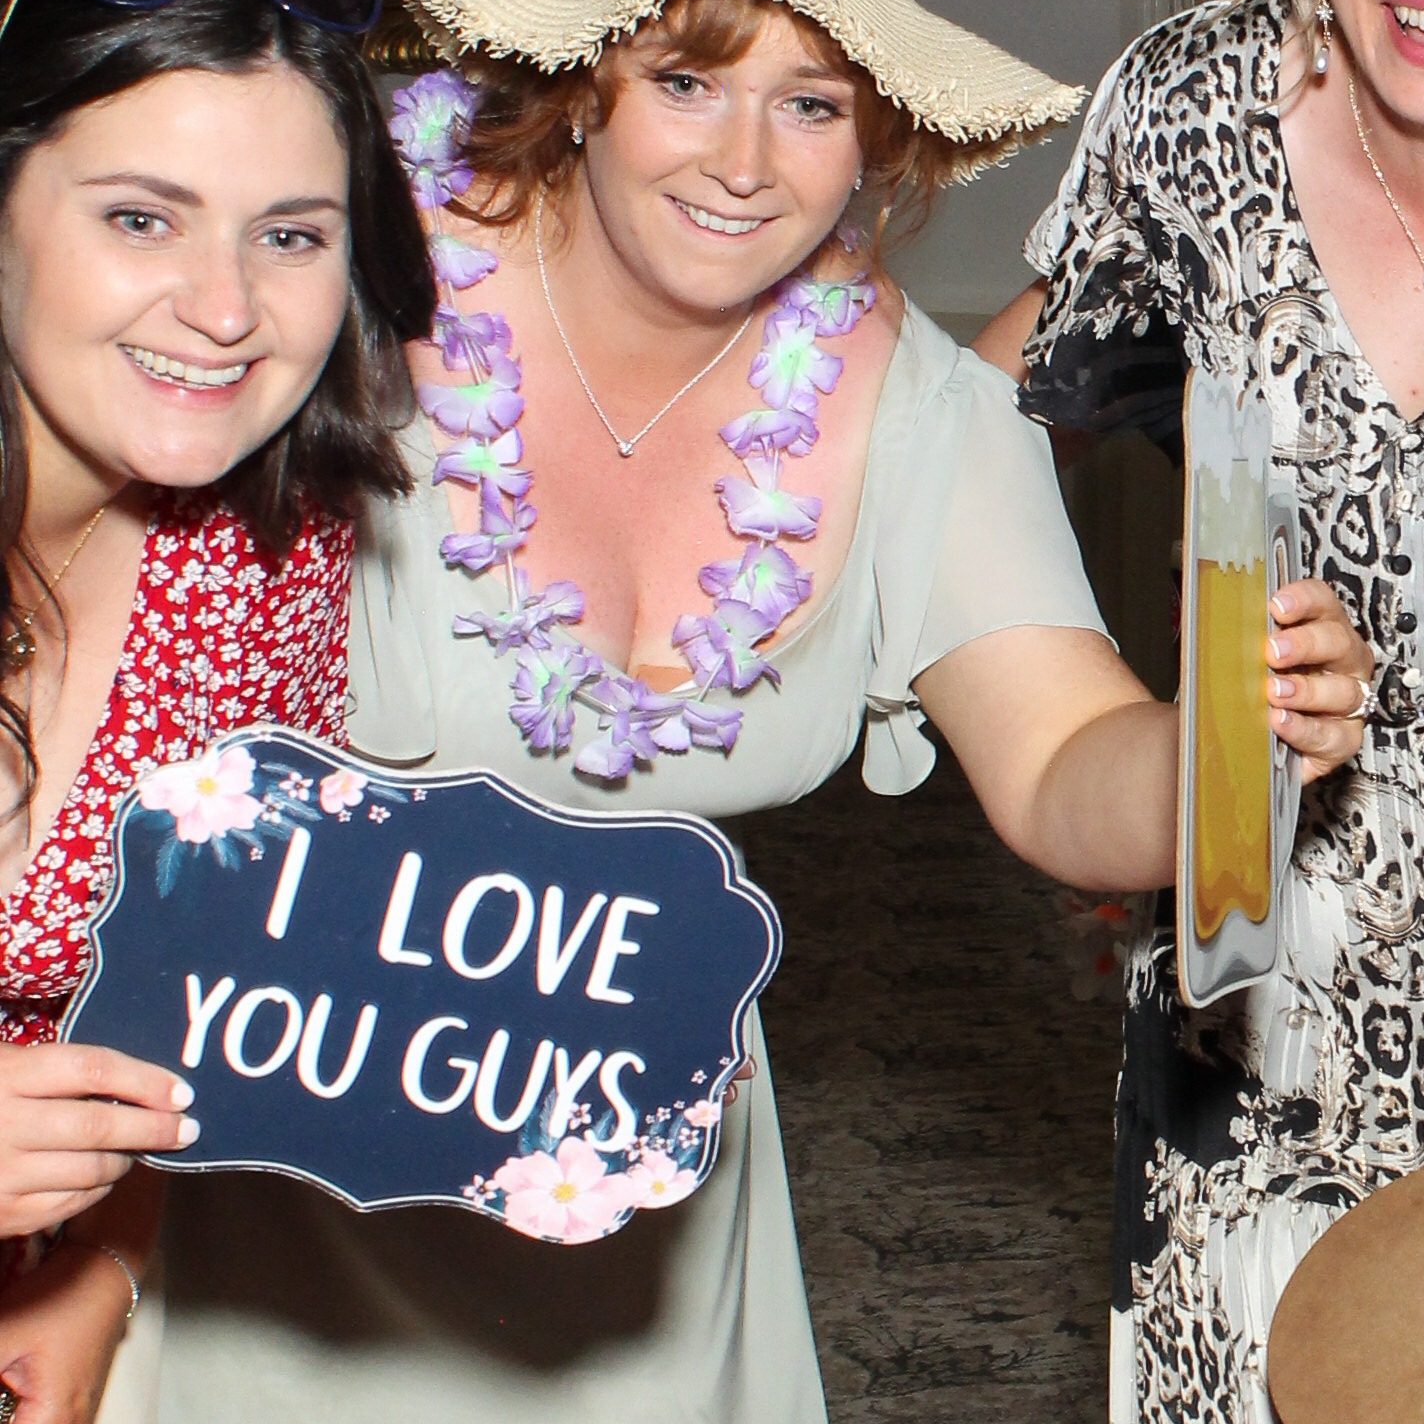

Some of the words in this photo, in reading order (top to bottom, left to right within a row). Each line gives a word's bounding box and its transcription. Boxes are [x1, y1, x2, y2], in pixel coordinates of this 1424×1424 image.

[265, 826, 311, 940] I
[376, 851, 660, 1005] LOVE
[179, 973, 378, 1099] YOU
[400, 1016, 646, 1153] GUYS
